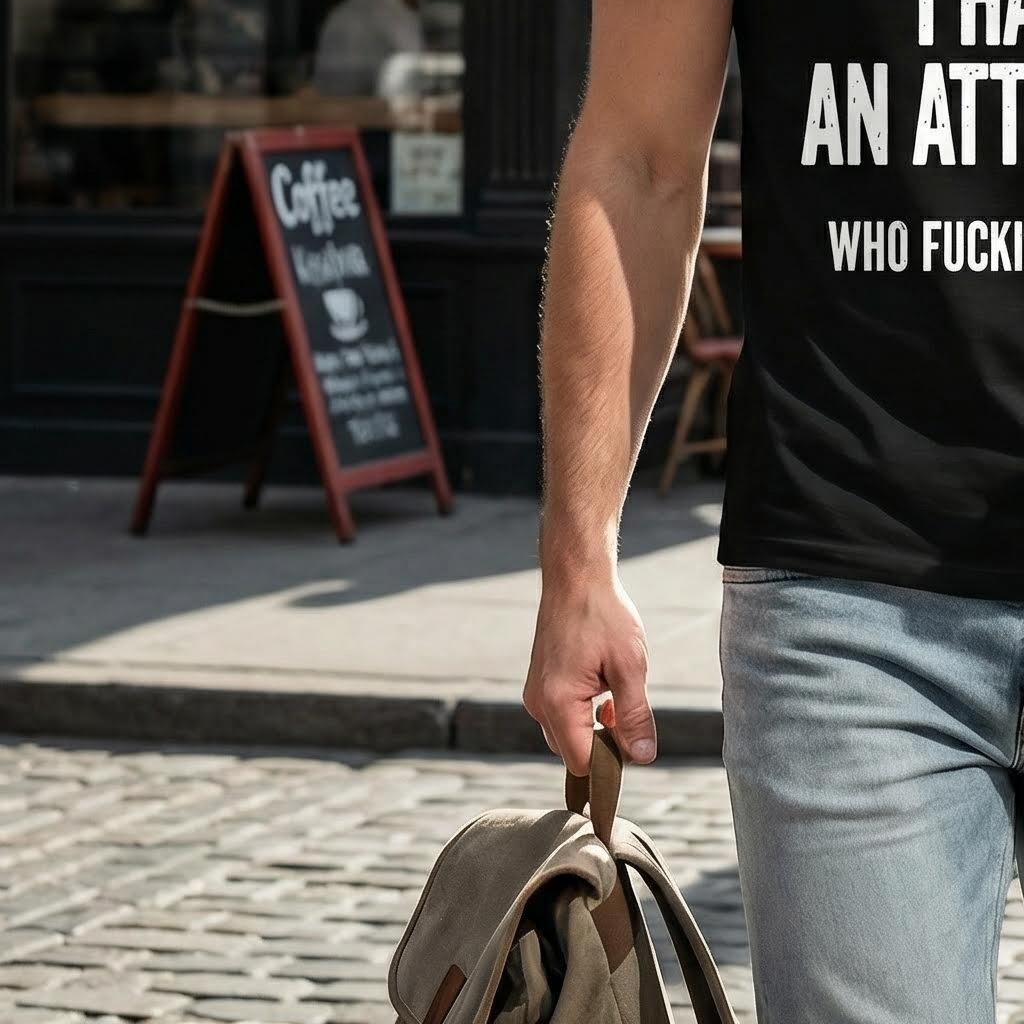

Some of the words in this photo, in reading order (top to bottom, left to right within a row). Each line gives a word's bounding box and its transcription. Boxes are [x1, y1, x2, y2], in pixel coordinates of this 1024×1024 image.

[800, 62, 889, 167] AN
[271, 160, 360, 236] Coffee
[828, 220, 909, 272] WHO
